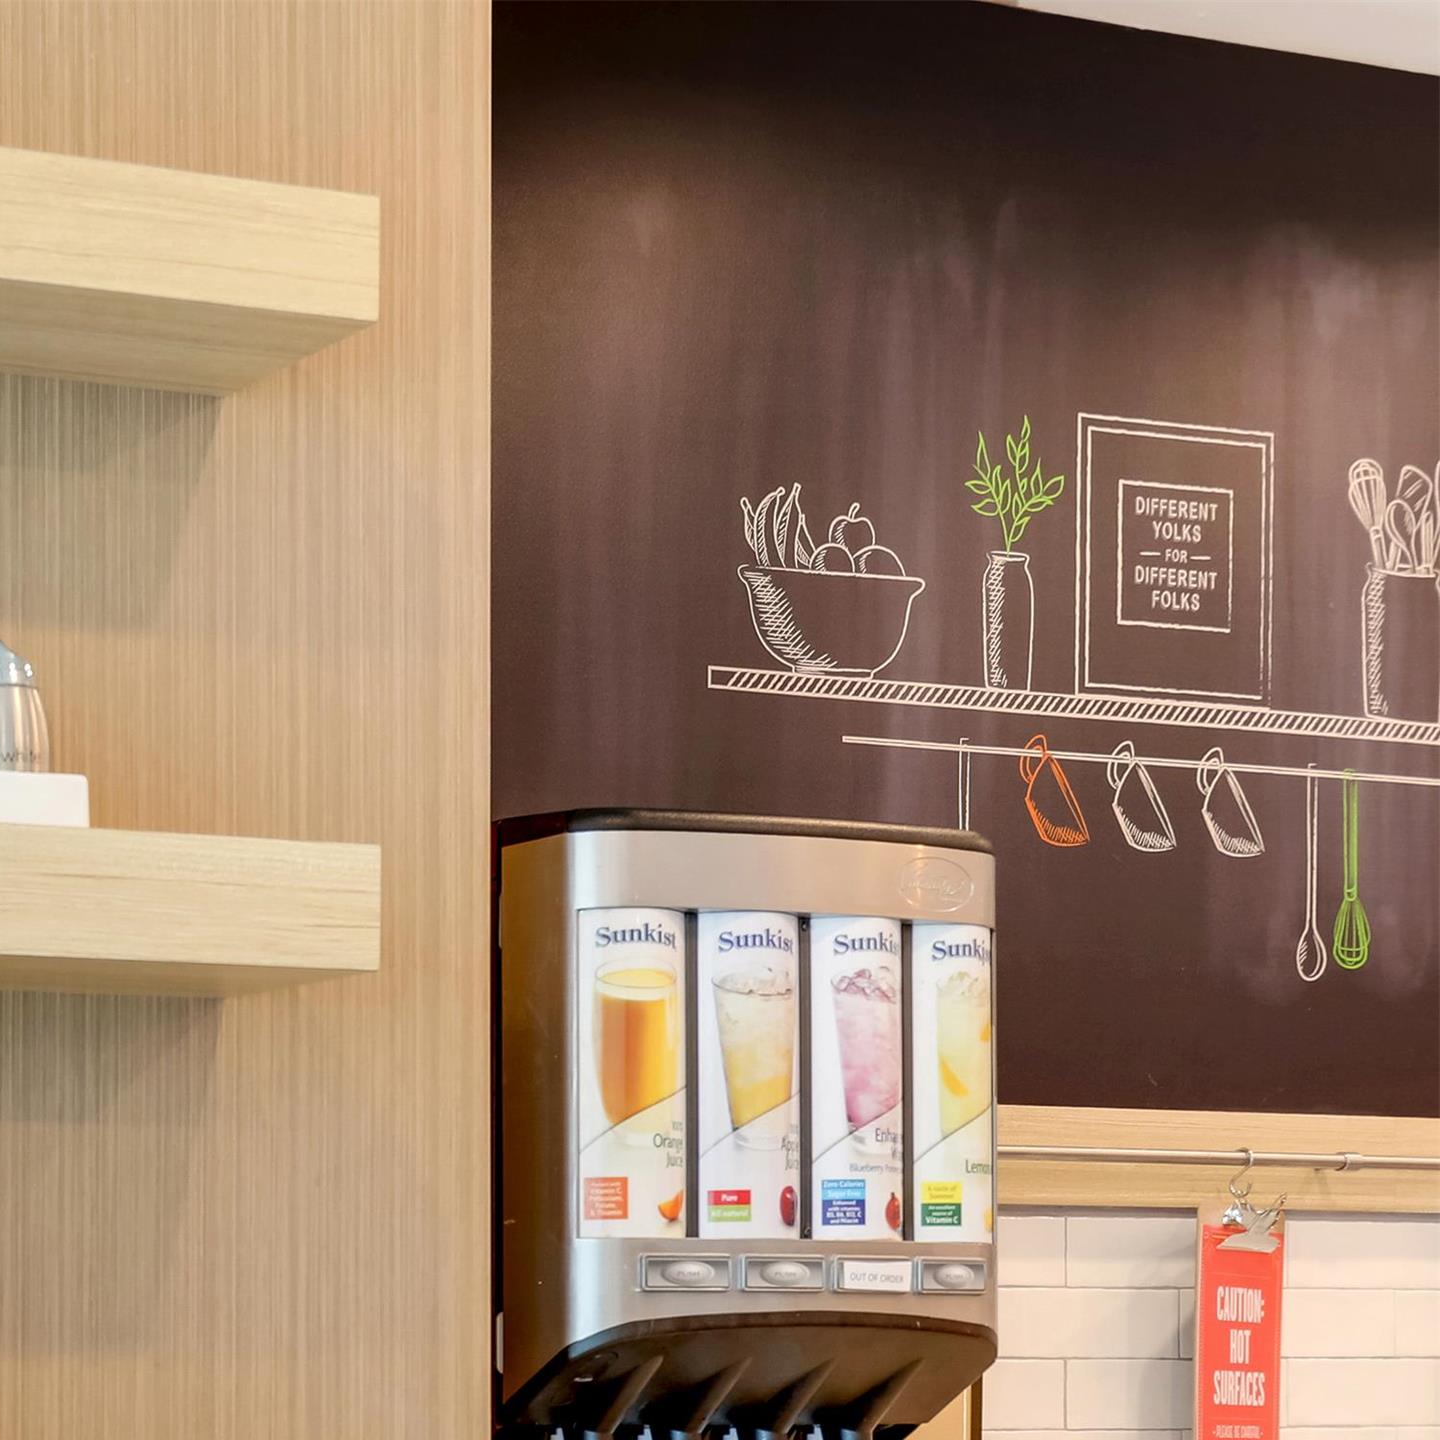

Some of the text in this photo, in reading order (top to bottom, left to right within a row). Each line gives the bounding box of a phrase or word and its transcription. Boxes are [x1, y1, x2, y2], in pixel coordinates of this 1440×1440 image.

[1135, 496, 1218, 521] DIFFERENT
[1153, 521, 1201, 543] YOLKS
[1165, 549, 1188, 564] FOR
[1134, 565, 1218, 590] DIFFERENT
[1151, 590, 1201, 612] FOLKS
[595, 922, 677, 949] Sunkist
[718, 928, 794, 954] Sunkist
[721, 1194, 739, 1202] Pure
[925, 1216, 953, 1224] Vitamin
[850, 1271, 867, 1281] OUT
[868, 1272, 879, 1282] OF
[1216, 1285, 1265, 1323] CAUTION:
[1229, 1329, 1251, 1364] HOT
[1213, 1370, 1265, 1406] SURFACES
